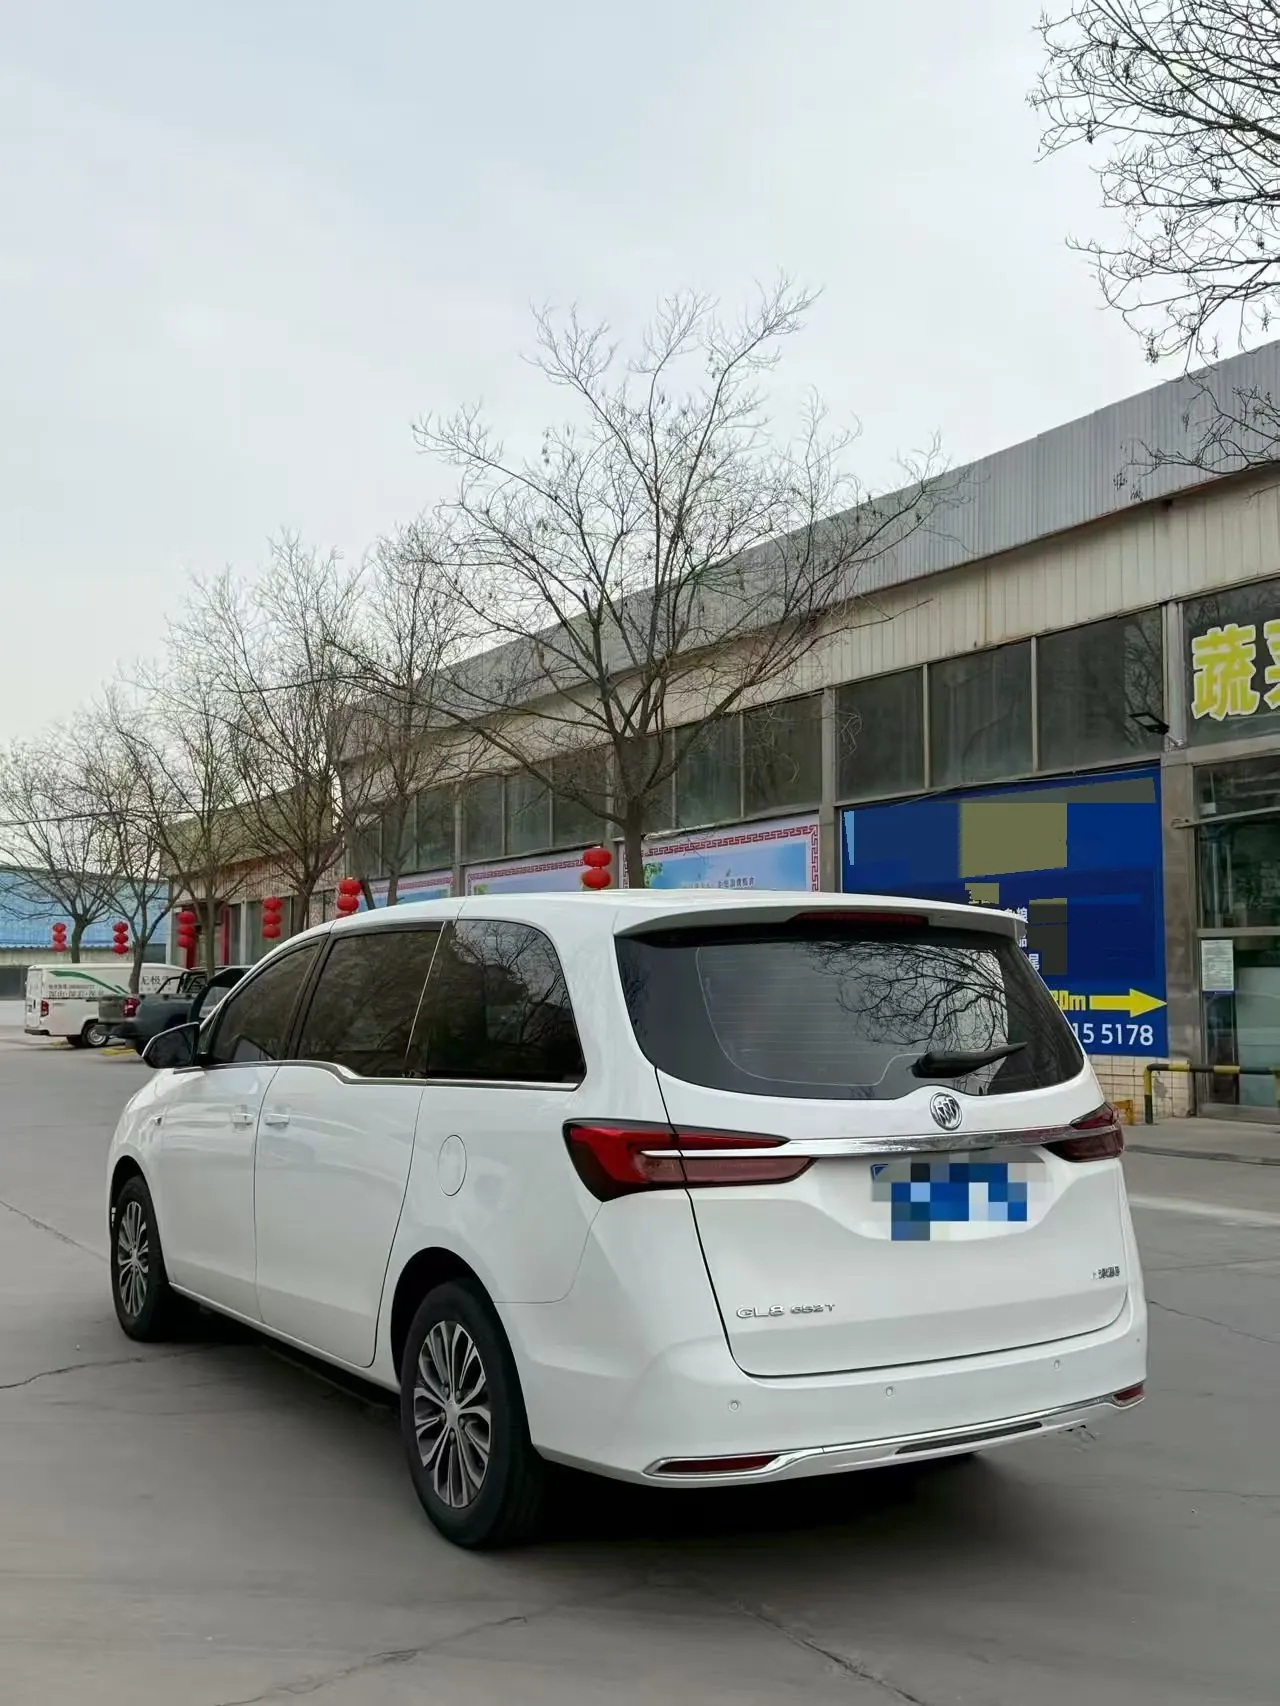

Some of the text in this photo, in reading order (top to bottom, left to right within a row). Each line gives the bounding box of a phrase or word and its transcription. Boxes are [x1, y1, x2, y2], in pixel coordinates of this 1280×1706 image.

[1191, 619, 1280, 721] 蔬
[1101, 1023, 1154, 1046] 5178
[736, 1305, 785, 1319] GL8
